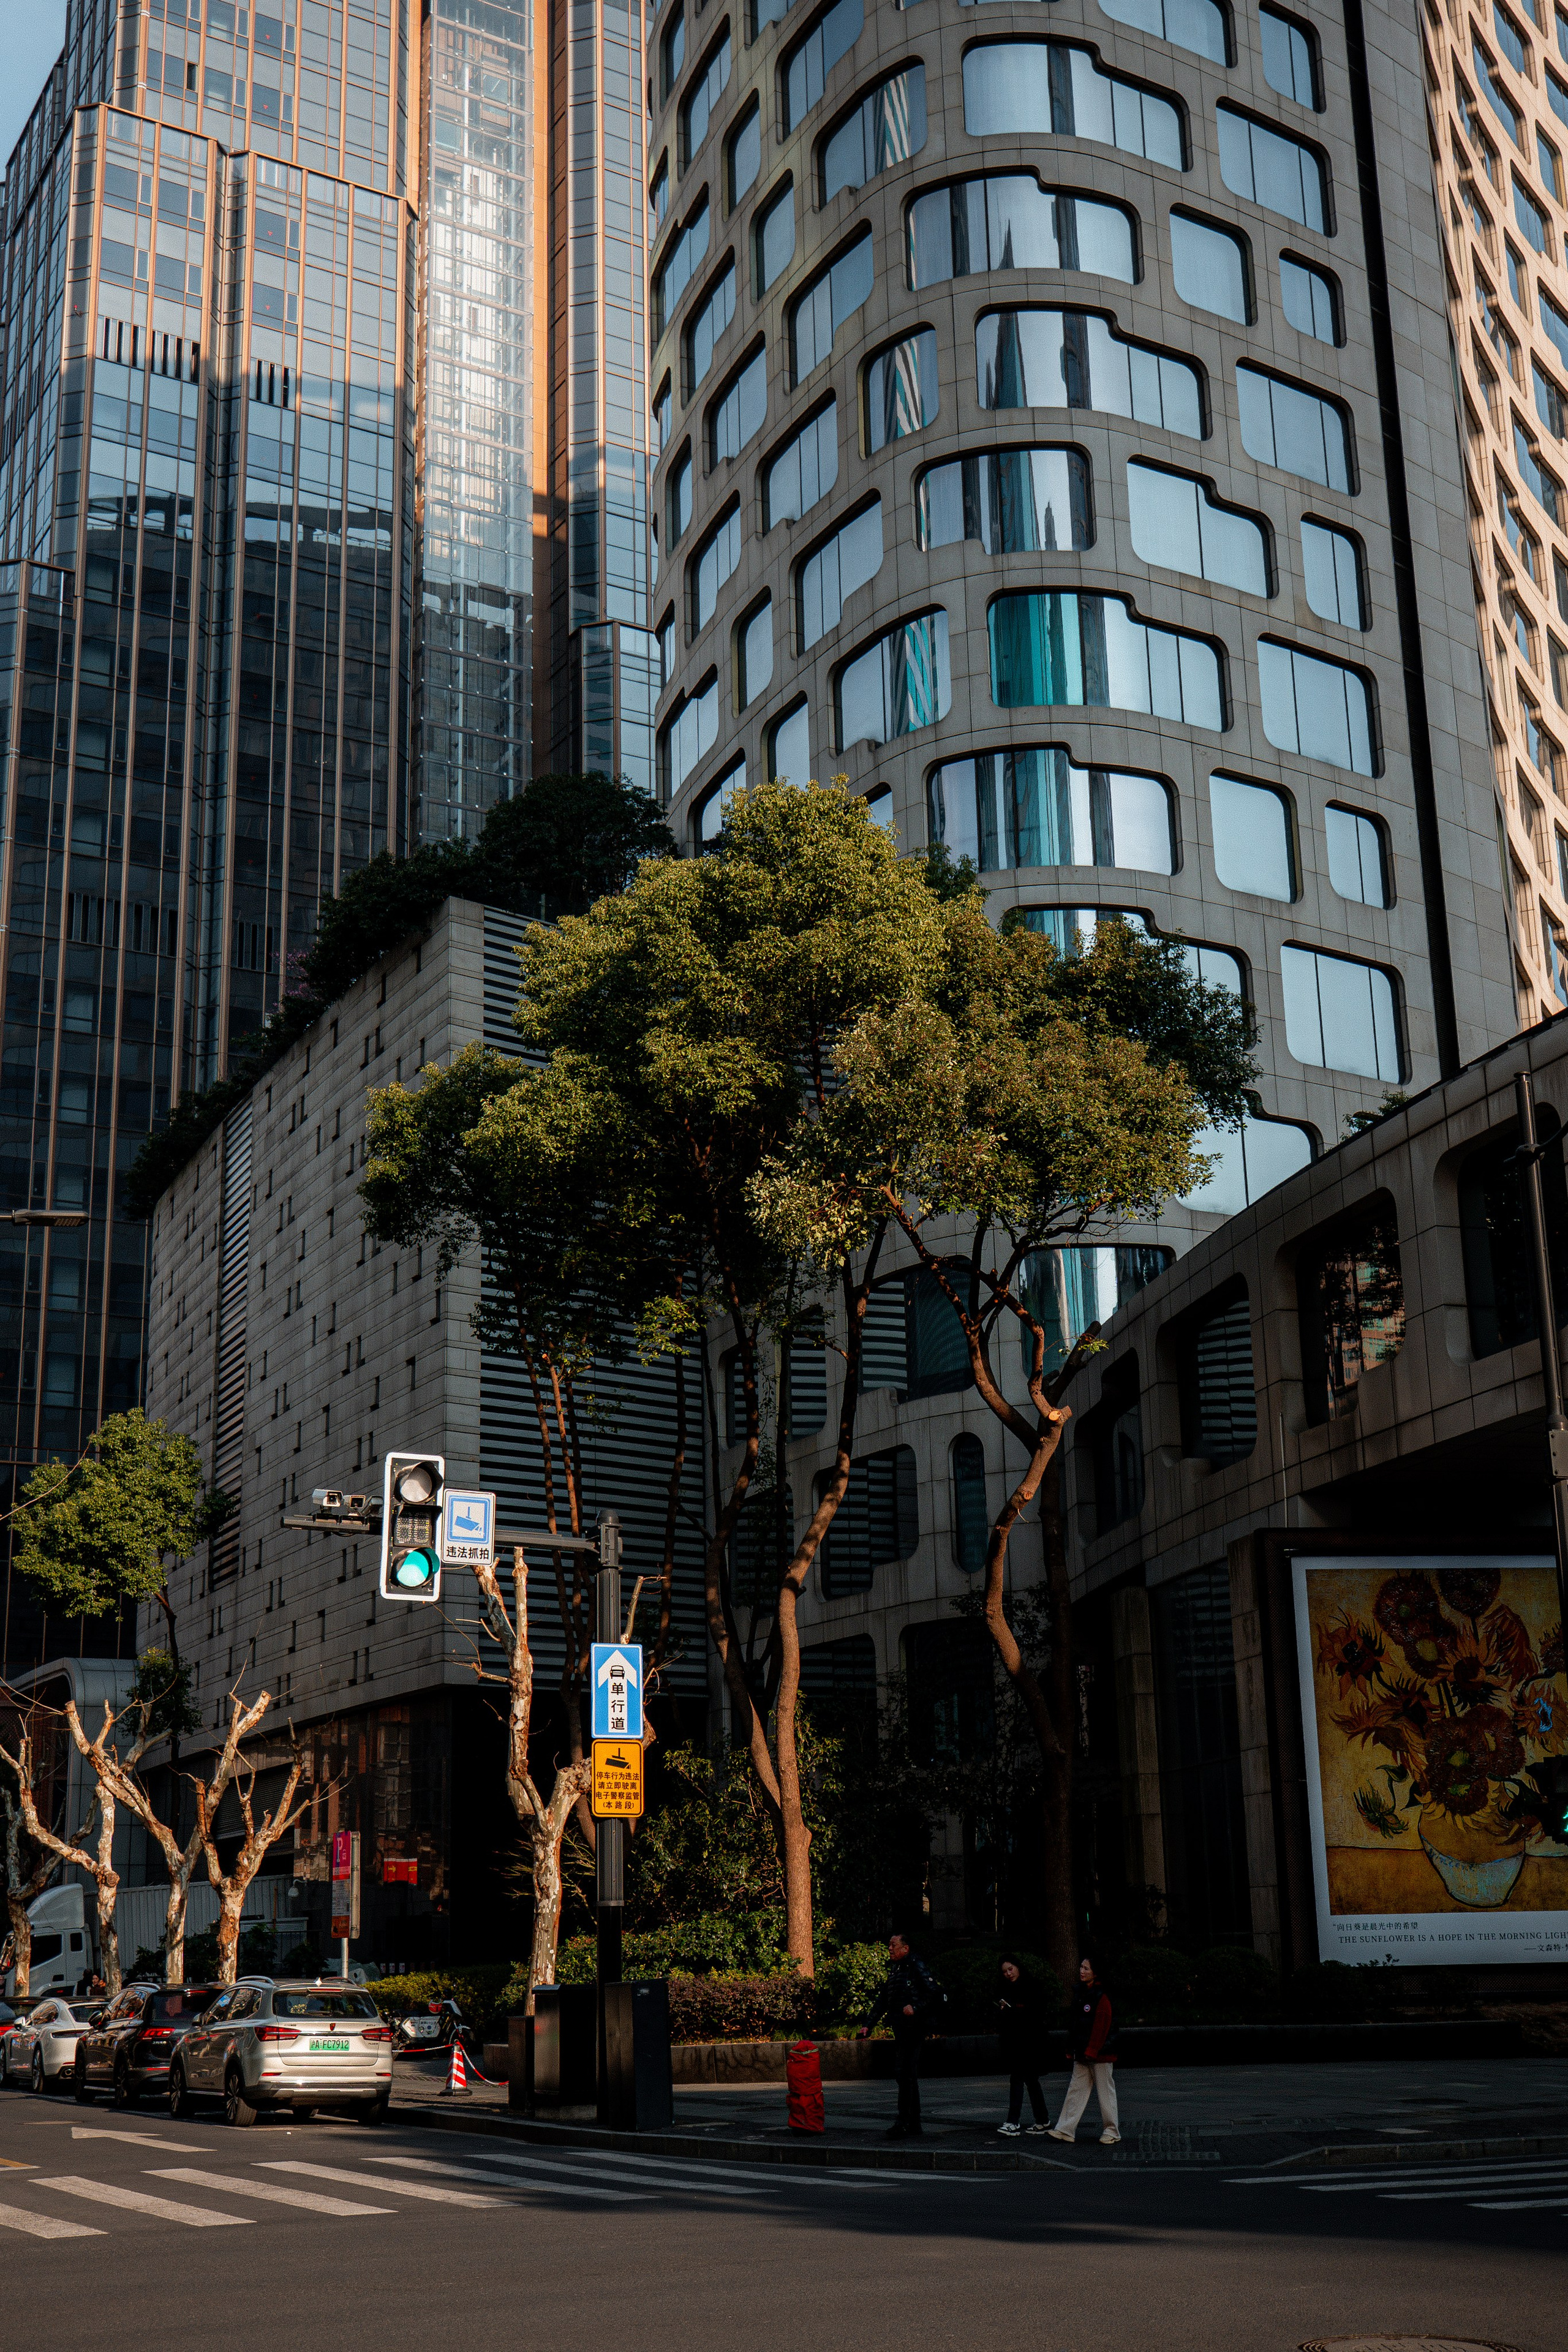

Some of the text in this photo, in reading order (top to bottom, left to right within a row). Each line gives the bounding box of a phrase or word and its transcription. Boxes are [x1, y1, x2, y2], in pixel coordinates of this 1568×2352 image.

[446, 1545, 489, 1560] 违法抓拍
[611, 1682, 625, 1730] 单行道
[596, 1771, 639, 1781] 停车行为违法
[598, 1781, 638, 1790] 请立即驶离
[595, 1791, 640, 1800] 电子警察监管
[1360, 1935, 1415, 1943] SUNFLOWER
[1499, 1932, 1542, 1940] MORNING
